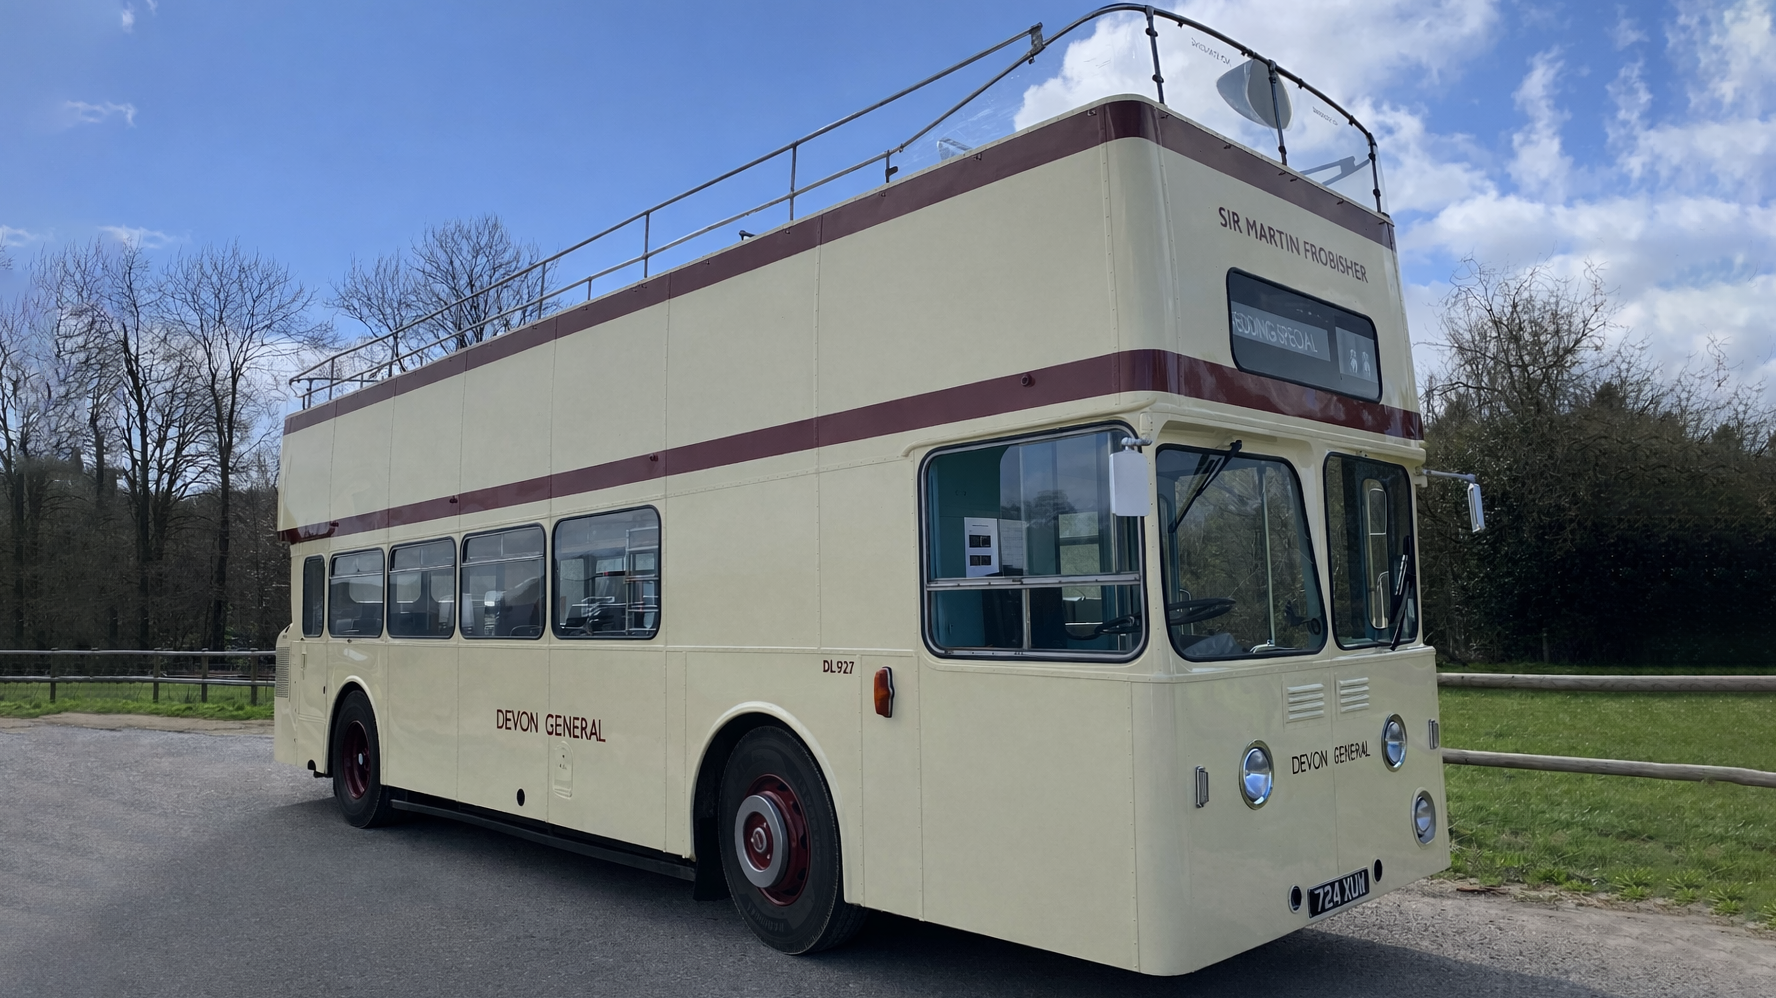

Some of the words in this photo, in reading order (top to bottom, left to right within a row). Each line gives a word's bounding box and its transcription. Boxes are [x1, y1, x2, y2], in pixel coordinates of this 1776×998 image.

[1218, 207, 1243, 234] SIR
[1245, 217, 1301, 256] MARTIN
[1303, 240, 1369, 284] FROBISHER
[822, 659, 855, 675] DL927
[496, 709, 539, 733] DEVON
[545, 713, 606, 743] GENERAL
[1291, 750, 1329, 775] DEVON
[1333, 740, 1371, 764] GENERAL
[1313, 881, 1342, 913] 724
